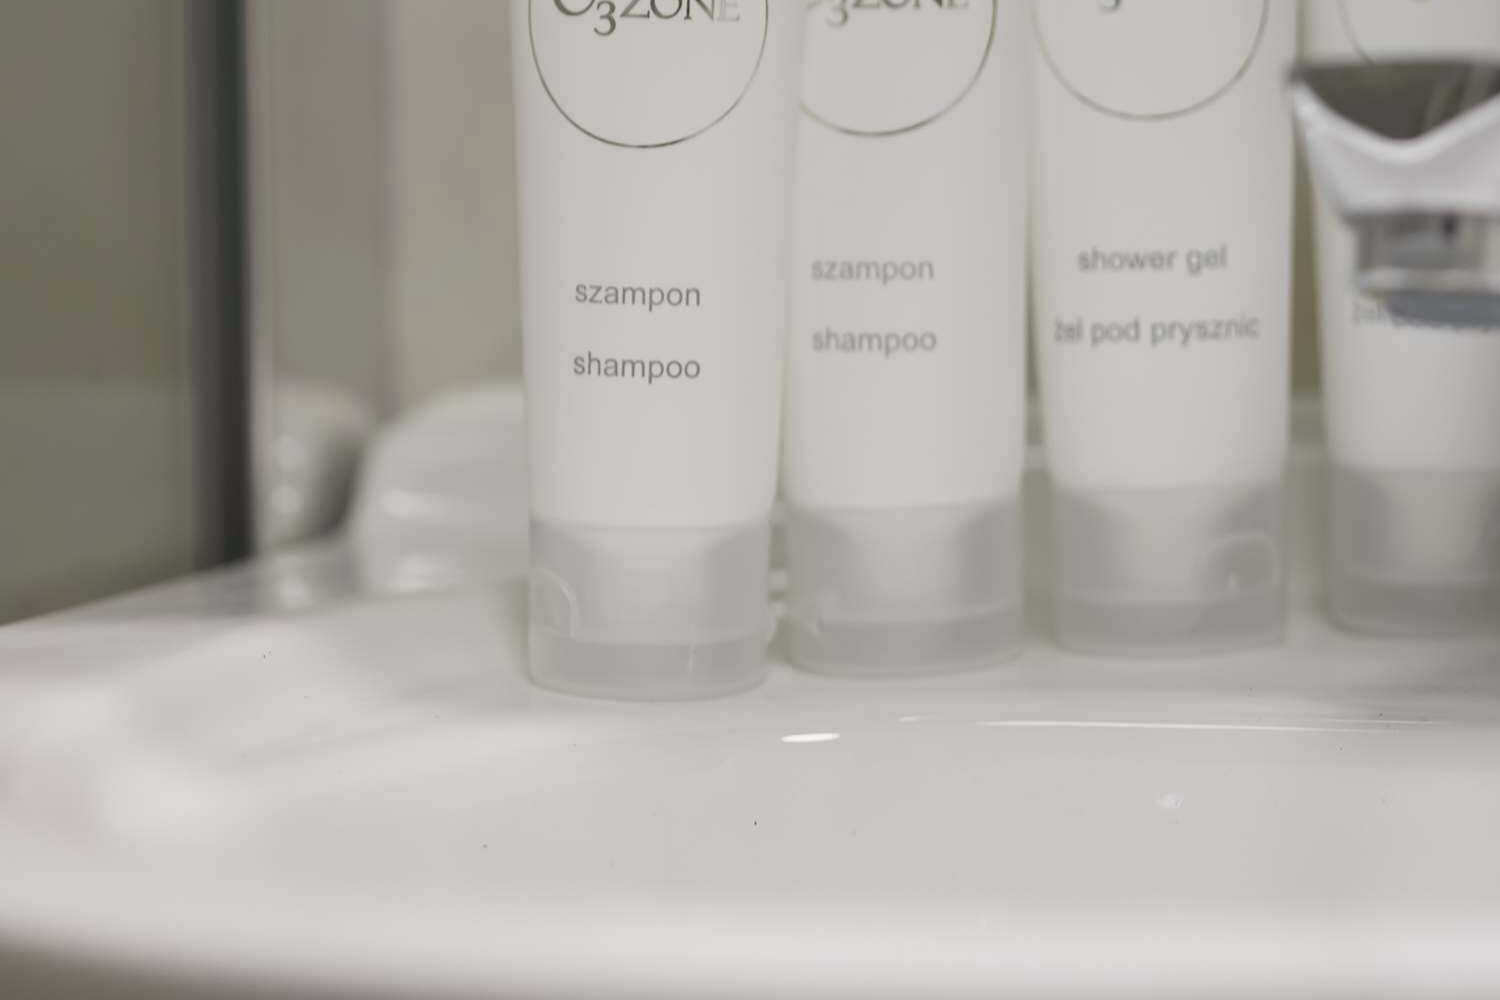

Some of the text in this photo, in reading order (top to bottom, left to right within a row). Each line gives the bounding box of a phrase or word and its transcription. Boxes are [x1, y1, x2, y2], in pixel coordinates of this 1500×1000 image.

[810, 256, 935, 285] szampon
[1077, 243, 1228, 277] shower gel
[574, 281, 701, 312] szampon
[812, 326, 939, 359] shampoo
[1091, 316, 1141, 347] pod
[1150, 314, 1261, 348] prysznic
[572, 352, 701, 385] shampoo
